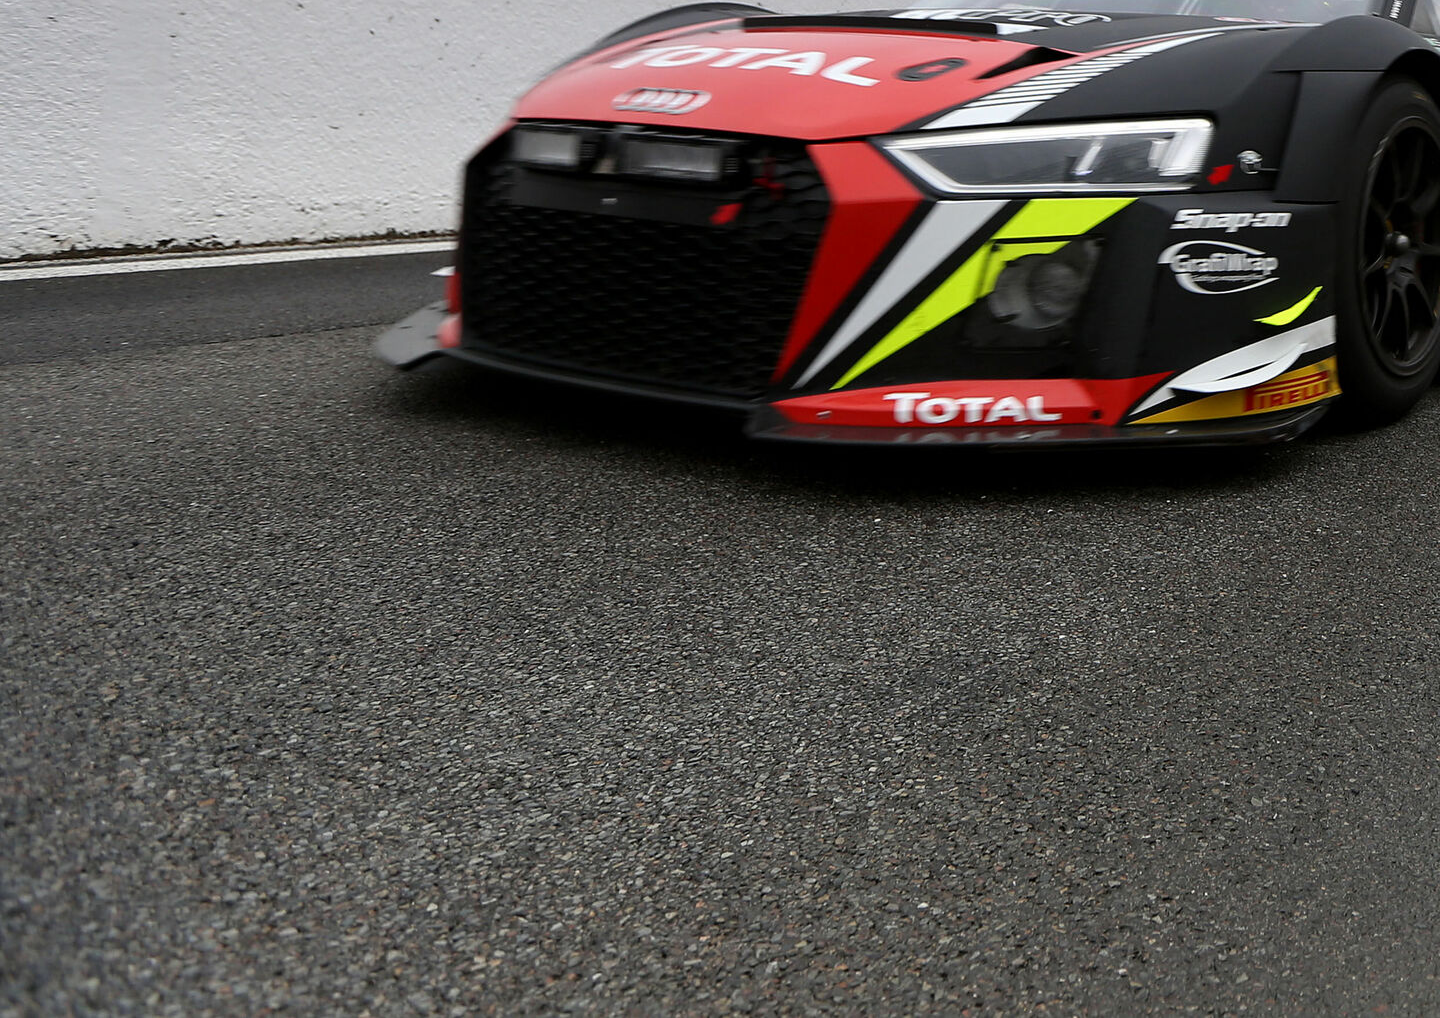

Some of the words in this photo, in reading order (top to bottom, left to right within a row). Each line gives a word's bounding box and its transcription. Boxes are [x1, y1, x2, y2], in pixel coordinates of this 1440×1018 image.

[610, 45, 881, 87] TOTAL
[883, 392, 1063, 424] TOTAL
[1243, 369, 1330, 413] PIRELLI
